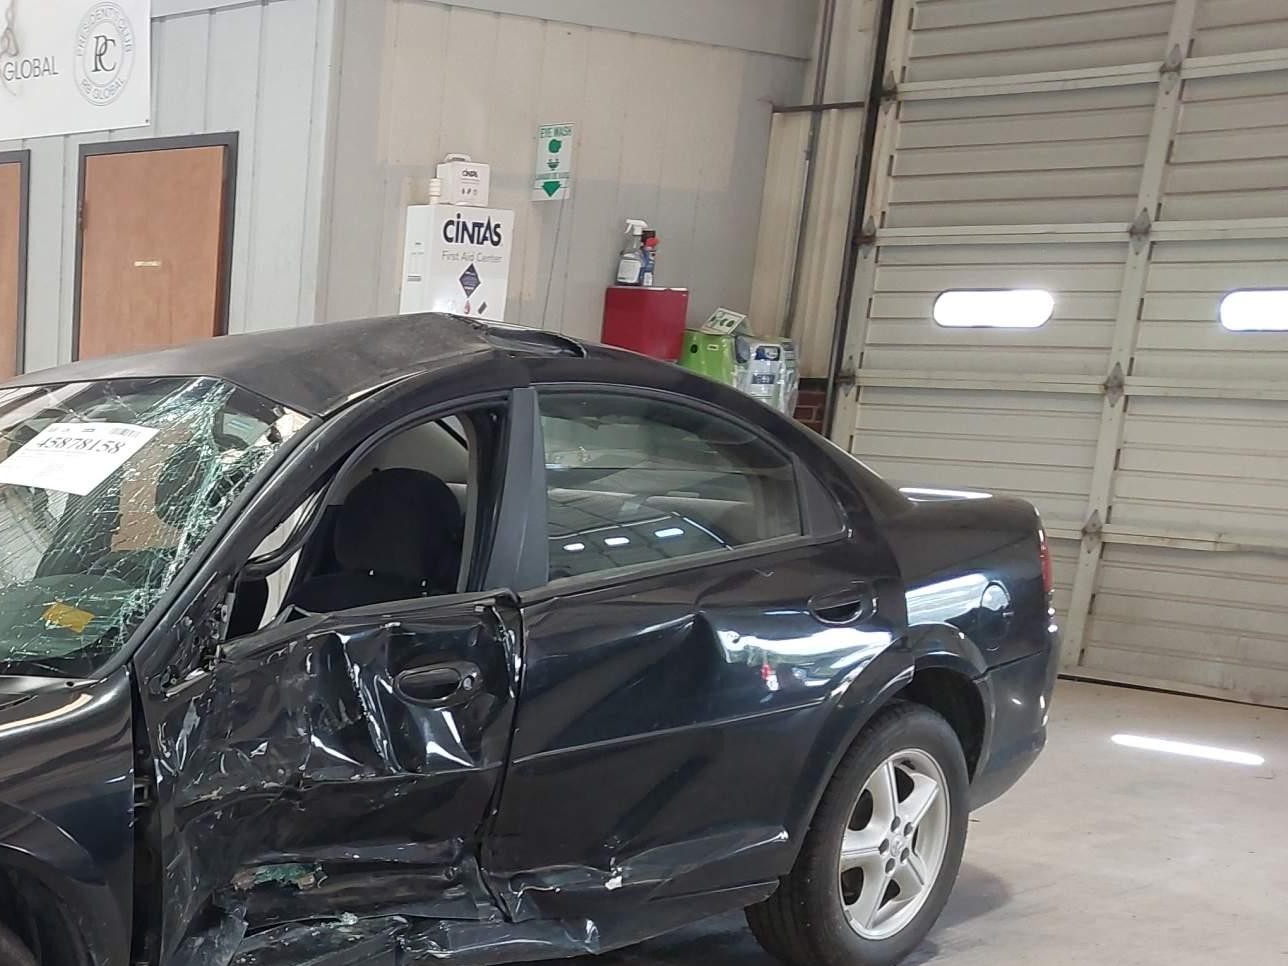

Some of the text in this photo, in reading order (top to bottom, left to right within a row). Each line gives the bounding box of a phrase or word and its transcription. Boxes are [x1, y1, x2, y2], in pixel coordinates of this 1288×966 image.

[442, 250, 503, 263] First Aid Center
[37, 436, 126, 454] 45878158
